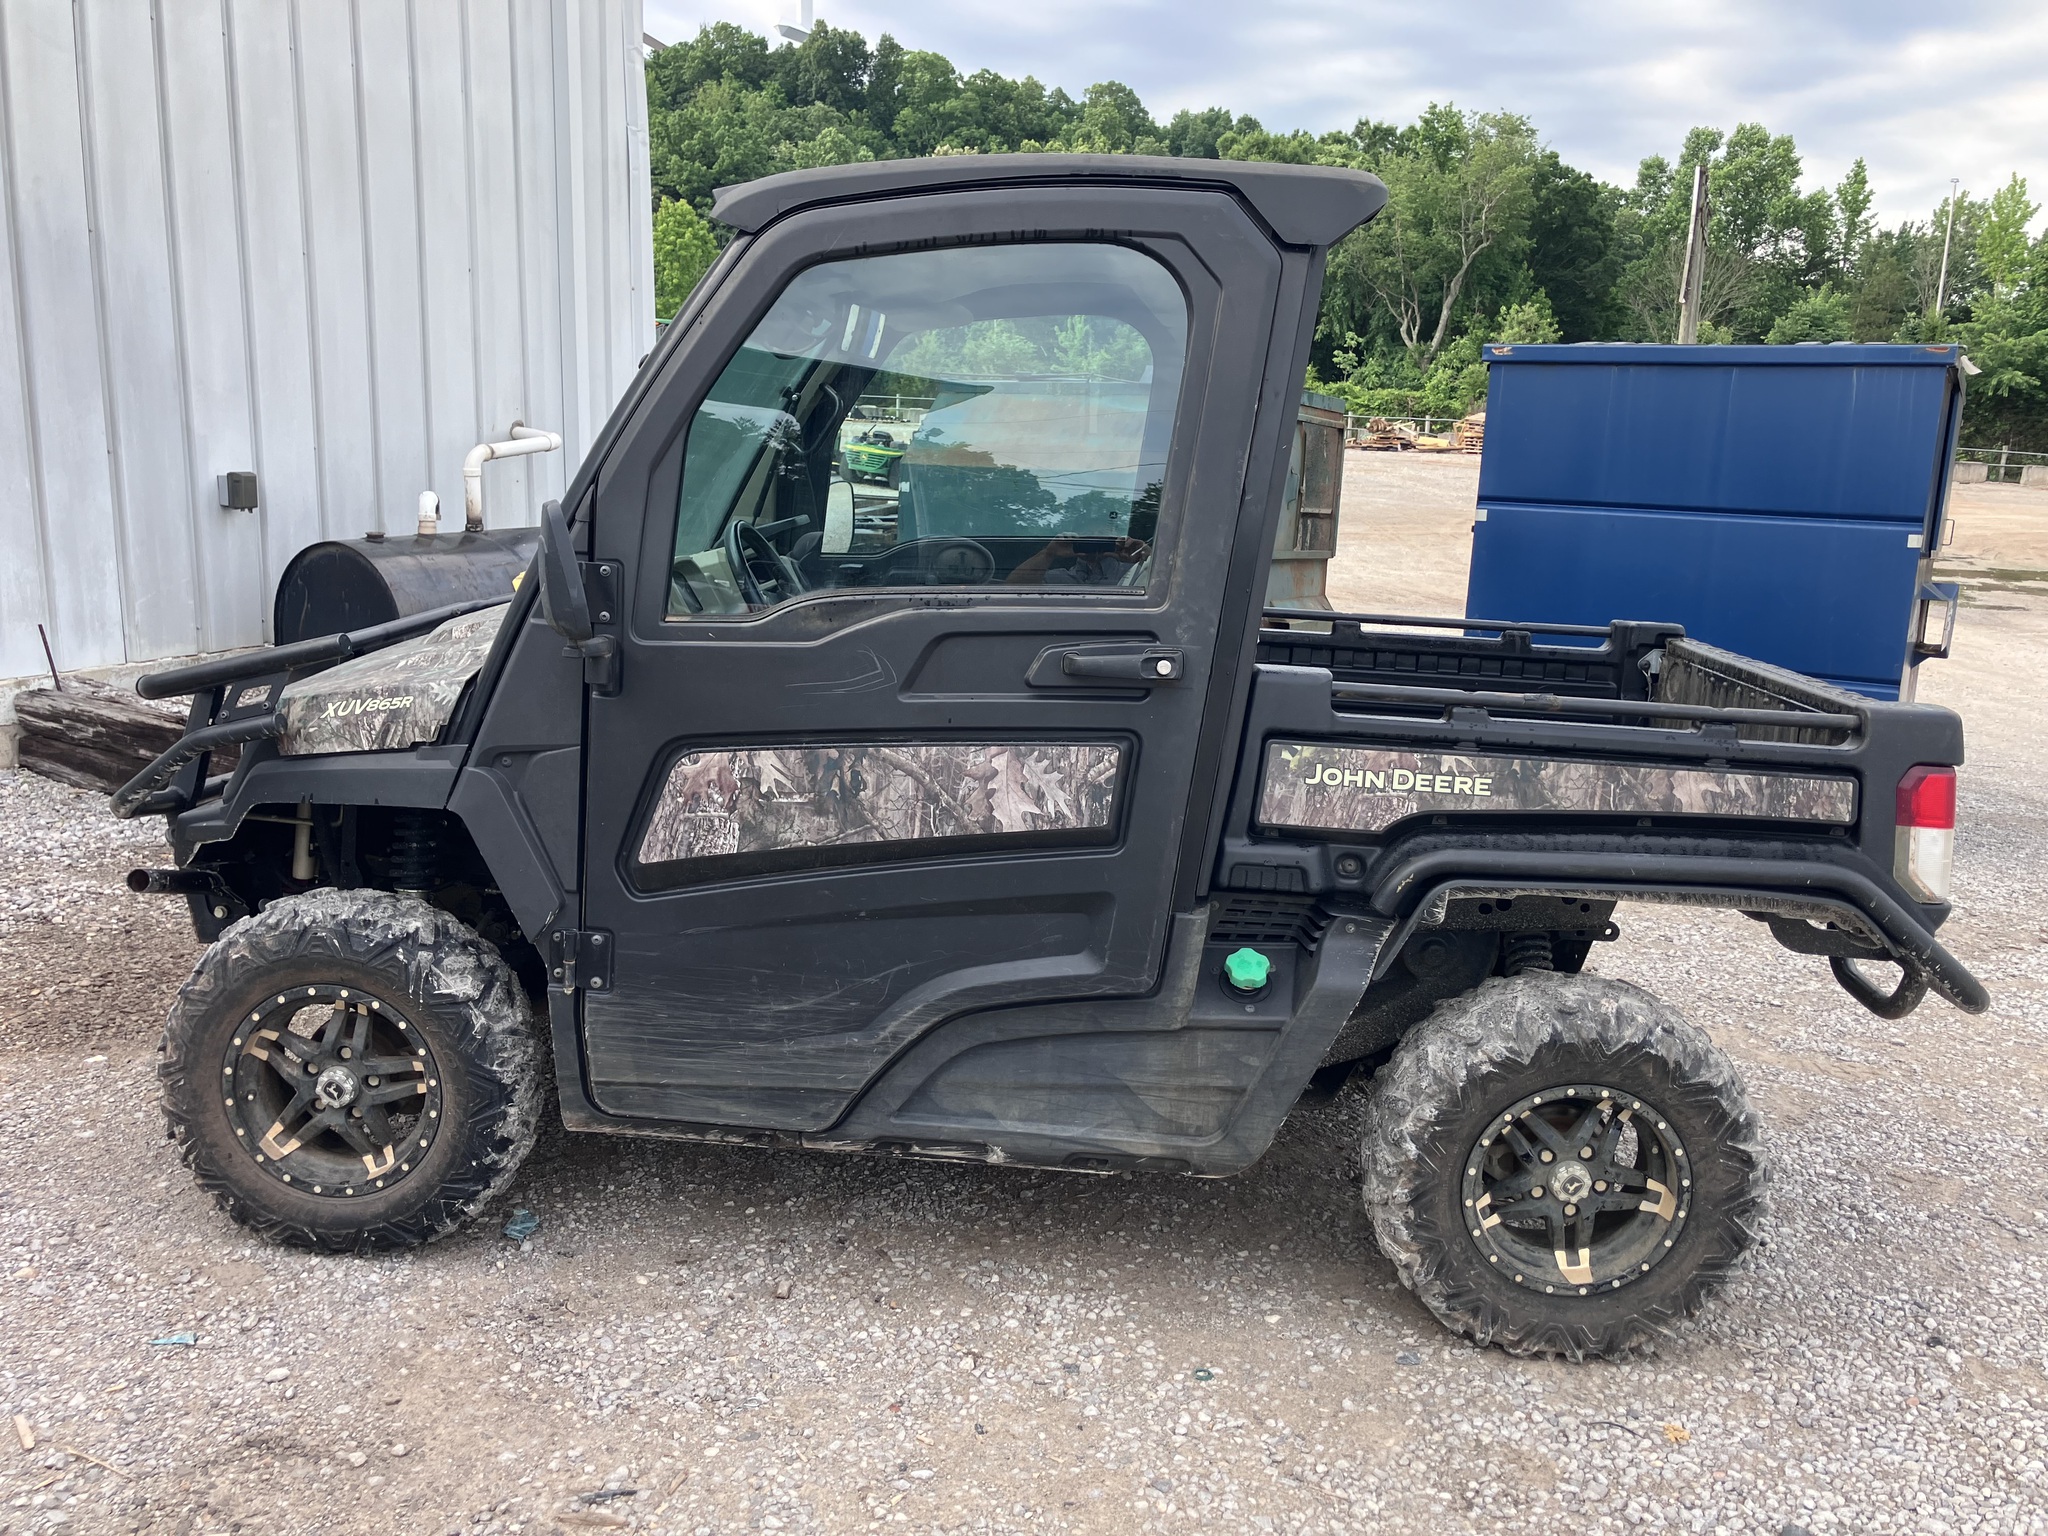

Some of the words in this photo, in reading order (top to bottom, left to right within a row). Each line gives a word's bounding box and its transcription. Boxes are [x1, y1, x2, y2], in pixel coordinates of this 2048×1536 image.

[320, 696, 414, 719] XUV865R
[1305, 763, 1385, 789] JOHN
[1392, 768, 1493, 796] DEERE
